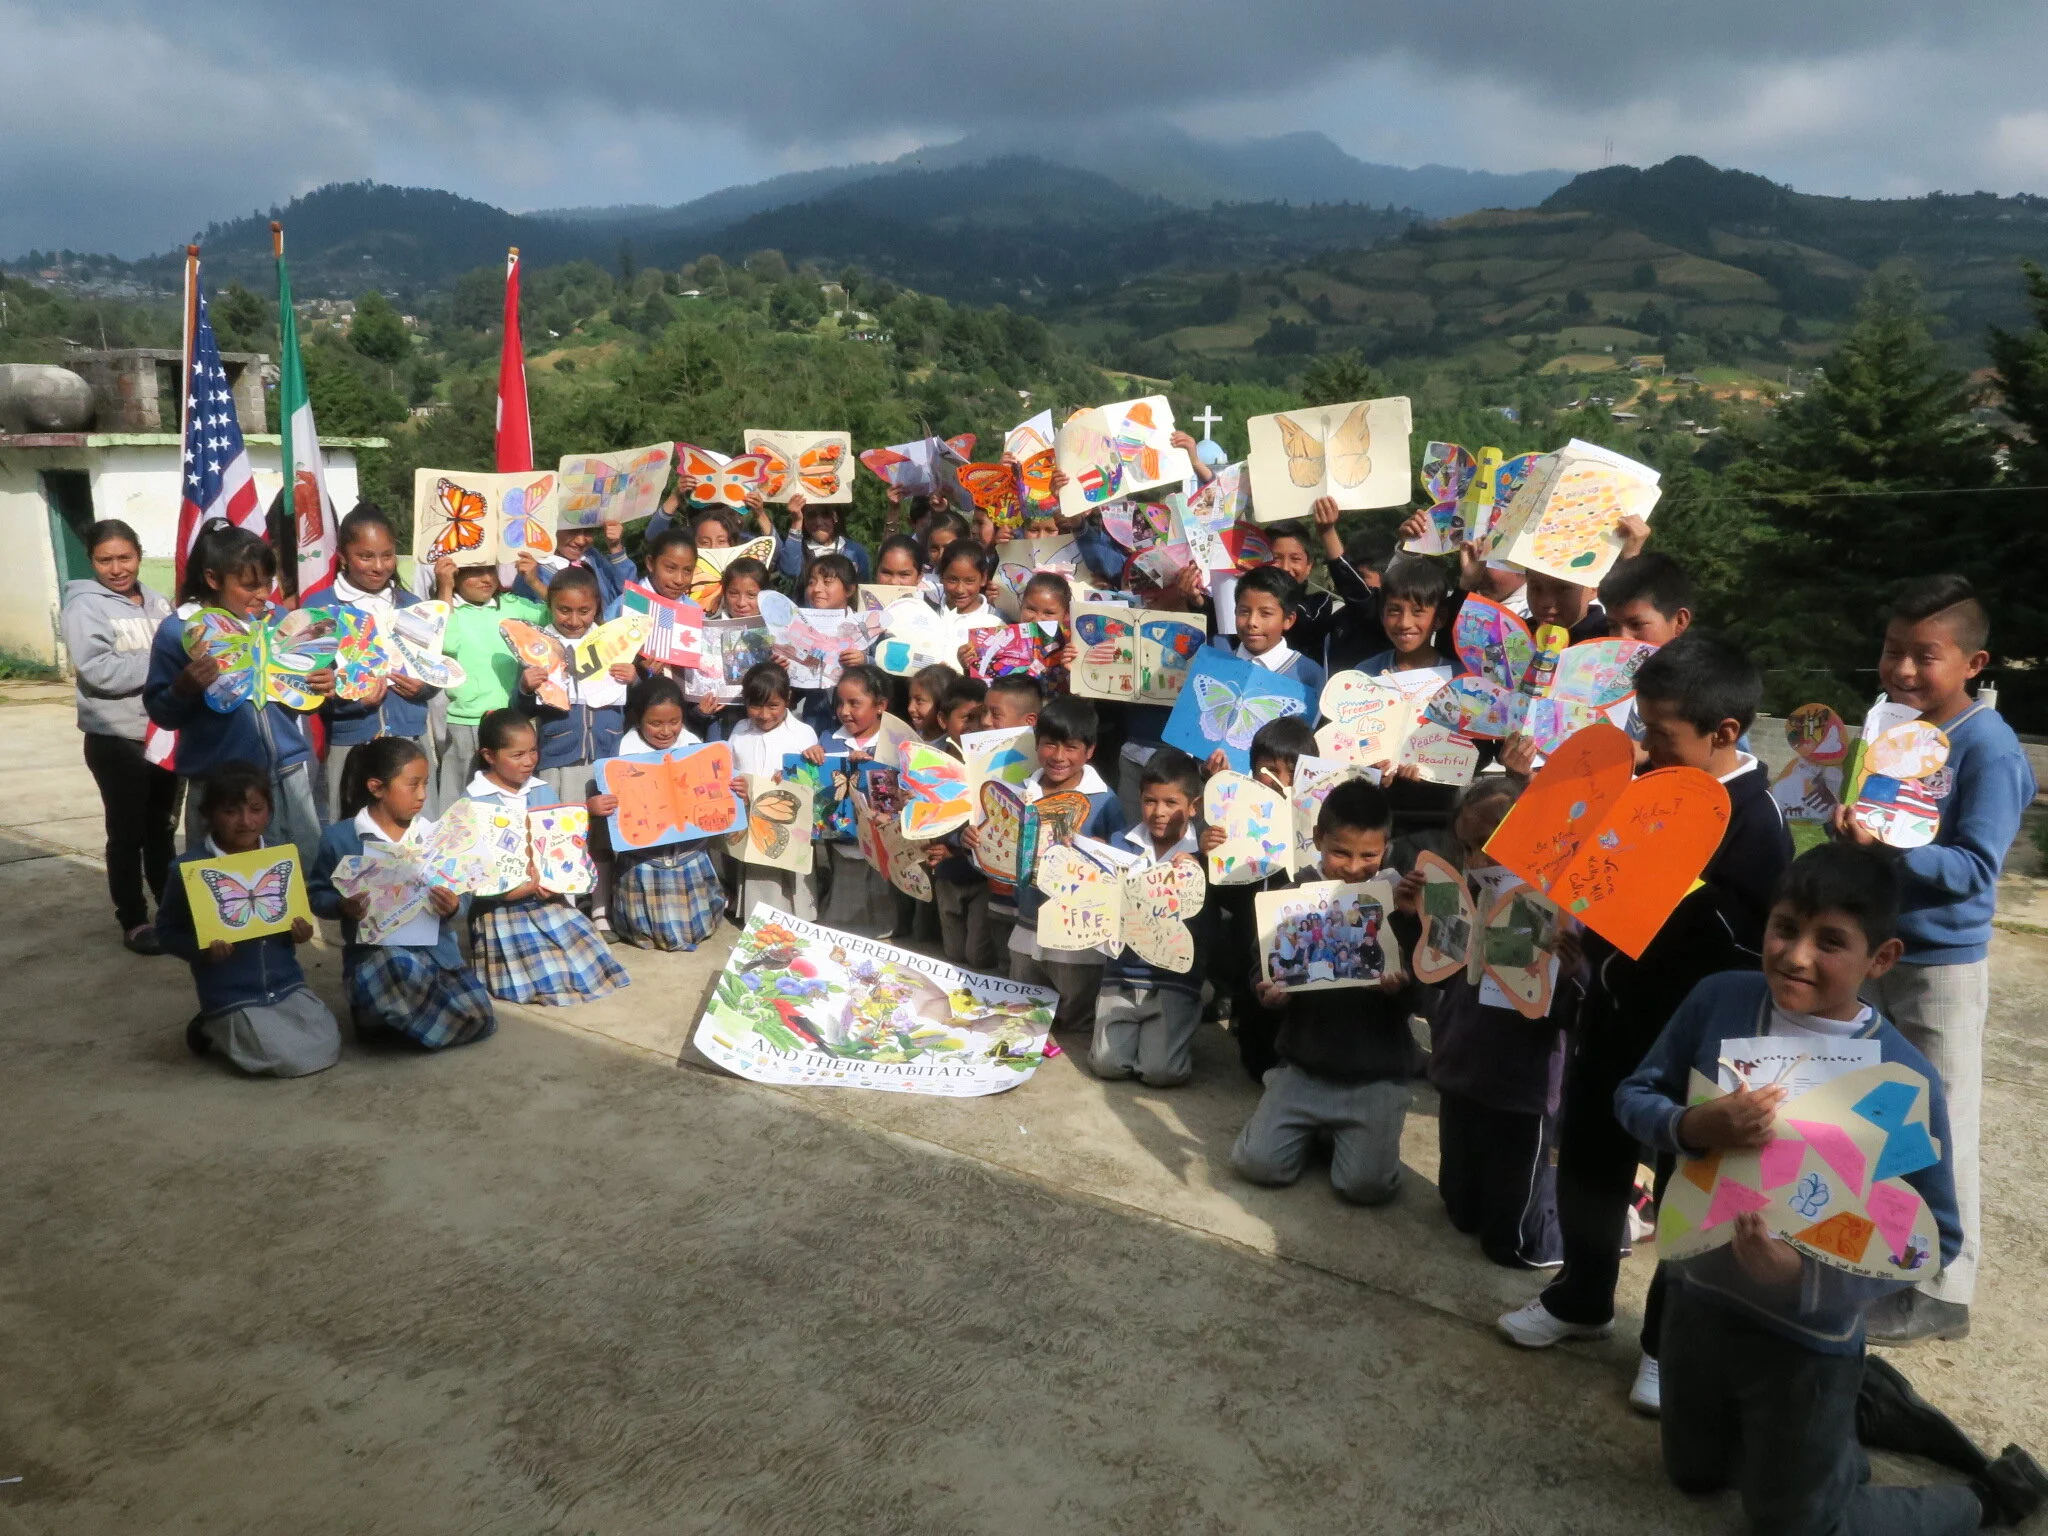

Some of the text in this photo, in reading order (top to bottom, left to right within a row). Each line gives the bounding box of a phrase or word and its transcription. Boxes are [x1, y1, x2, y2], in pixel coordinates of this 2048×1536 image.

[1341, 701, 1381, 717] Freedom
[1417, 754, 1471, 767] Beautiful
[1067, 863, 1097, 882] USA
[1146, 870, 1175, 885] USA
[1148, 887, 1173, 897] USA
[769, 910, 1045, 997] ENDANGERED POLLINATORS
[751, 1038, 799, 1062] AND
[805, 1053, 867, 1073] THEIR
[873, 1064, 977, 1078] HABITATS
